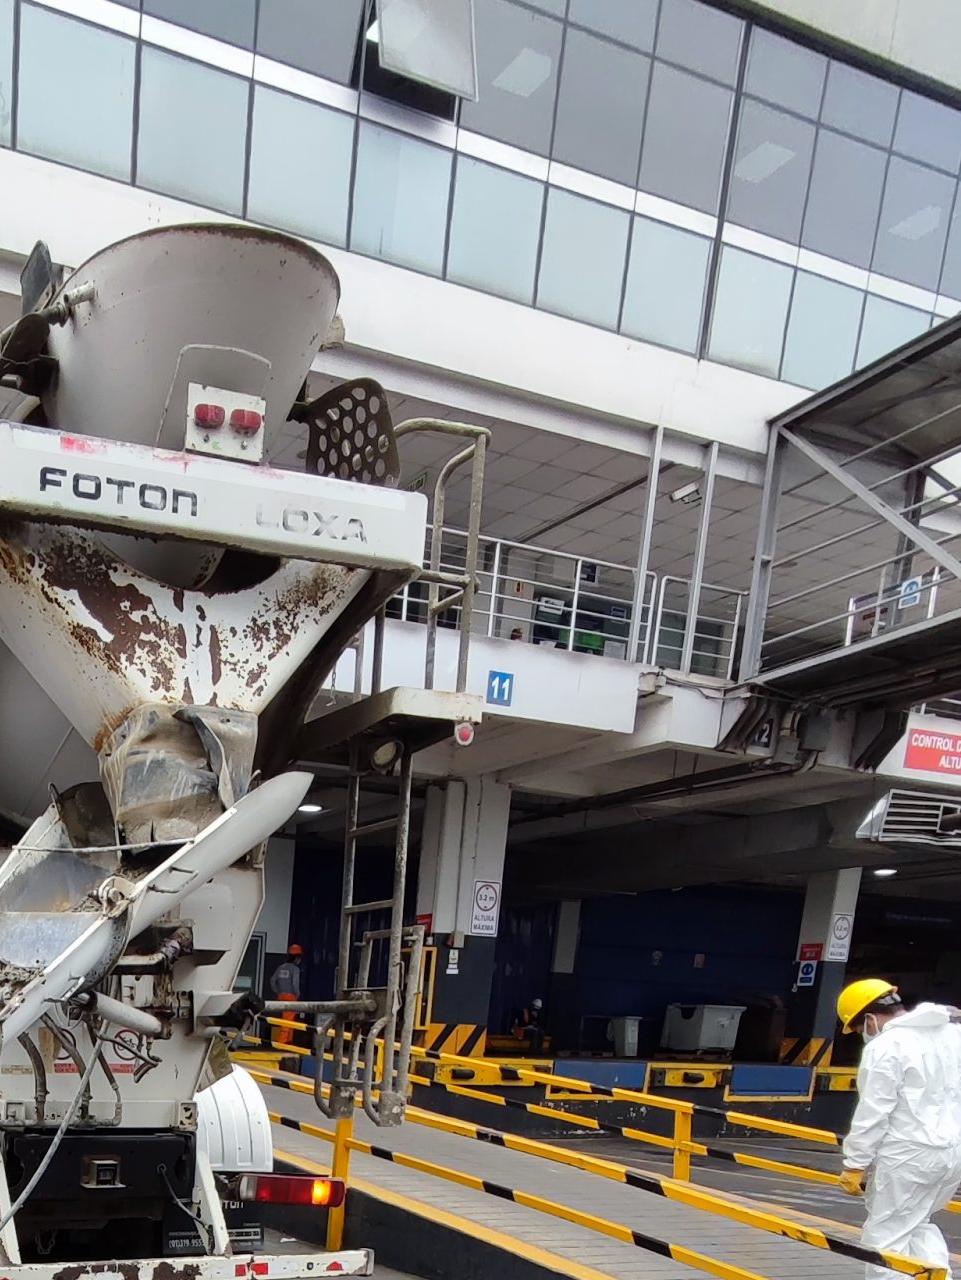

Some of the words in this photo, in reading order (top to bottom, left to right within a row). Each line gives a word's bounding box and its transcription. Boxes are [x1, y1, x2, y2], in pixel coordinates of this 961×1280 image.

[39, 466, 198, 517] FOTON
[255, 503, 368, 544] LOXA
[491, 676, 510, 701] 11
[912, 733, 954, 751] CONTROL
